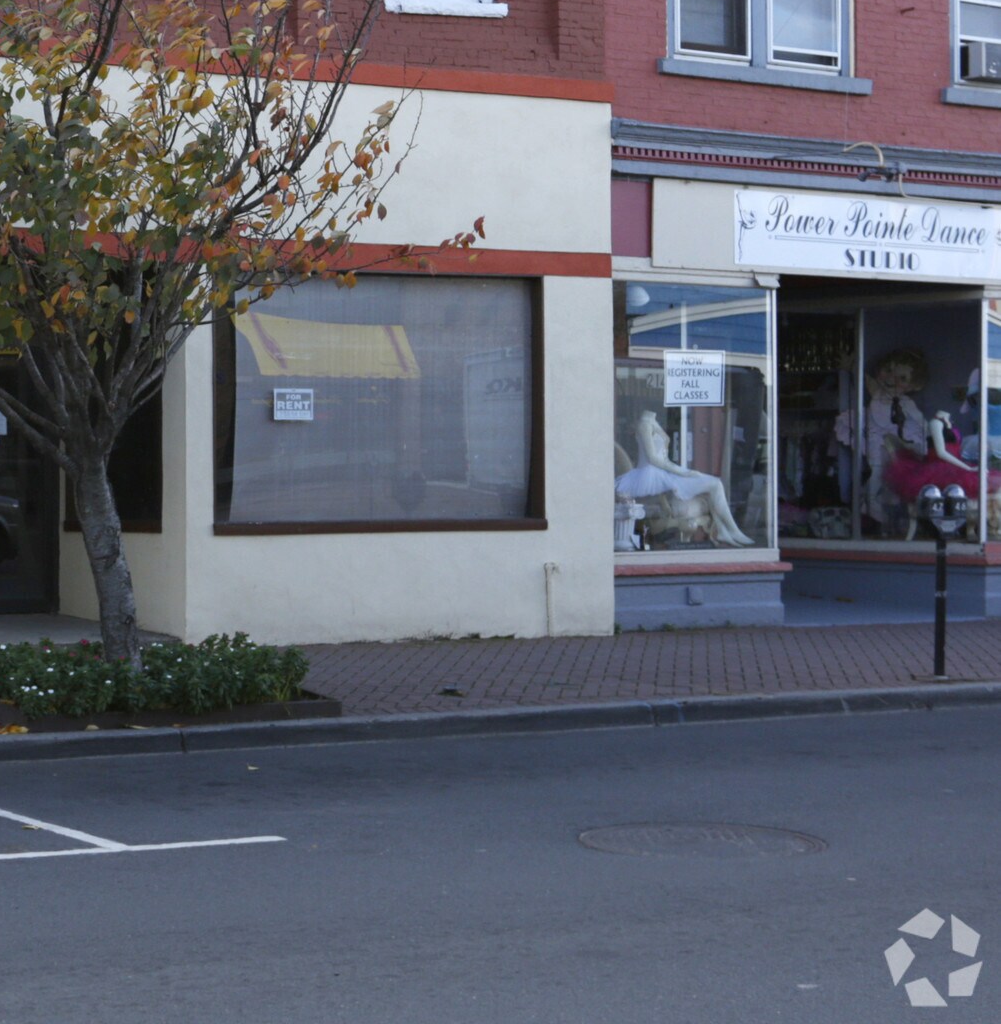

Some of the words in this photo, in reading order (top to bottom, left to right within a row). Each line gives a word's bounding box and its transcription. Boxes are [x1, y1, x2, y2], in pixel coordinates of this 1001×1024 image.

[765, 194, 837, 237] Power
[844, 200, 914, 242] Pointe
[921, 206, 988, 246] Dance
[843, 248, 920, 271] STUDIO
[681, 357, 703, 366] NOW
[681, 379, 700, 389] FALL
[673, 390, 709, 400] CLASSES
[277, 400, 310, 410] RENT
